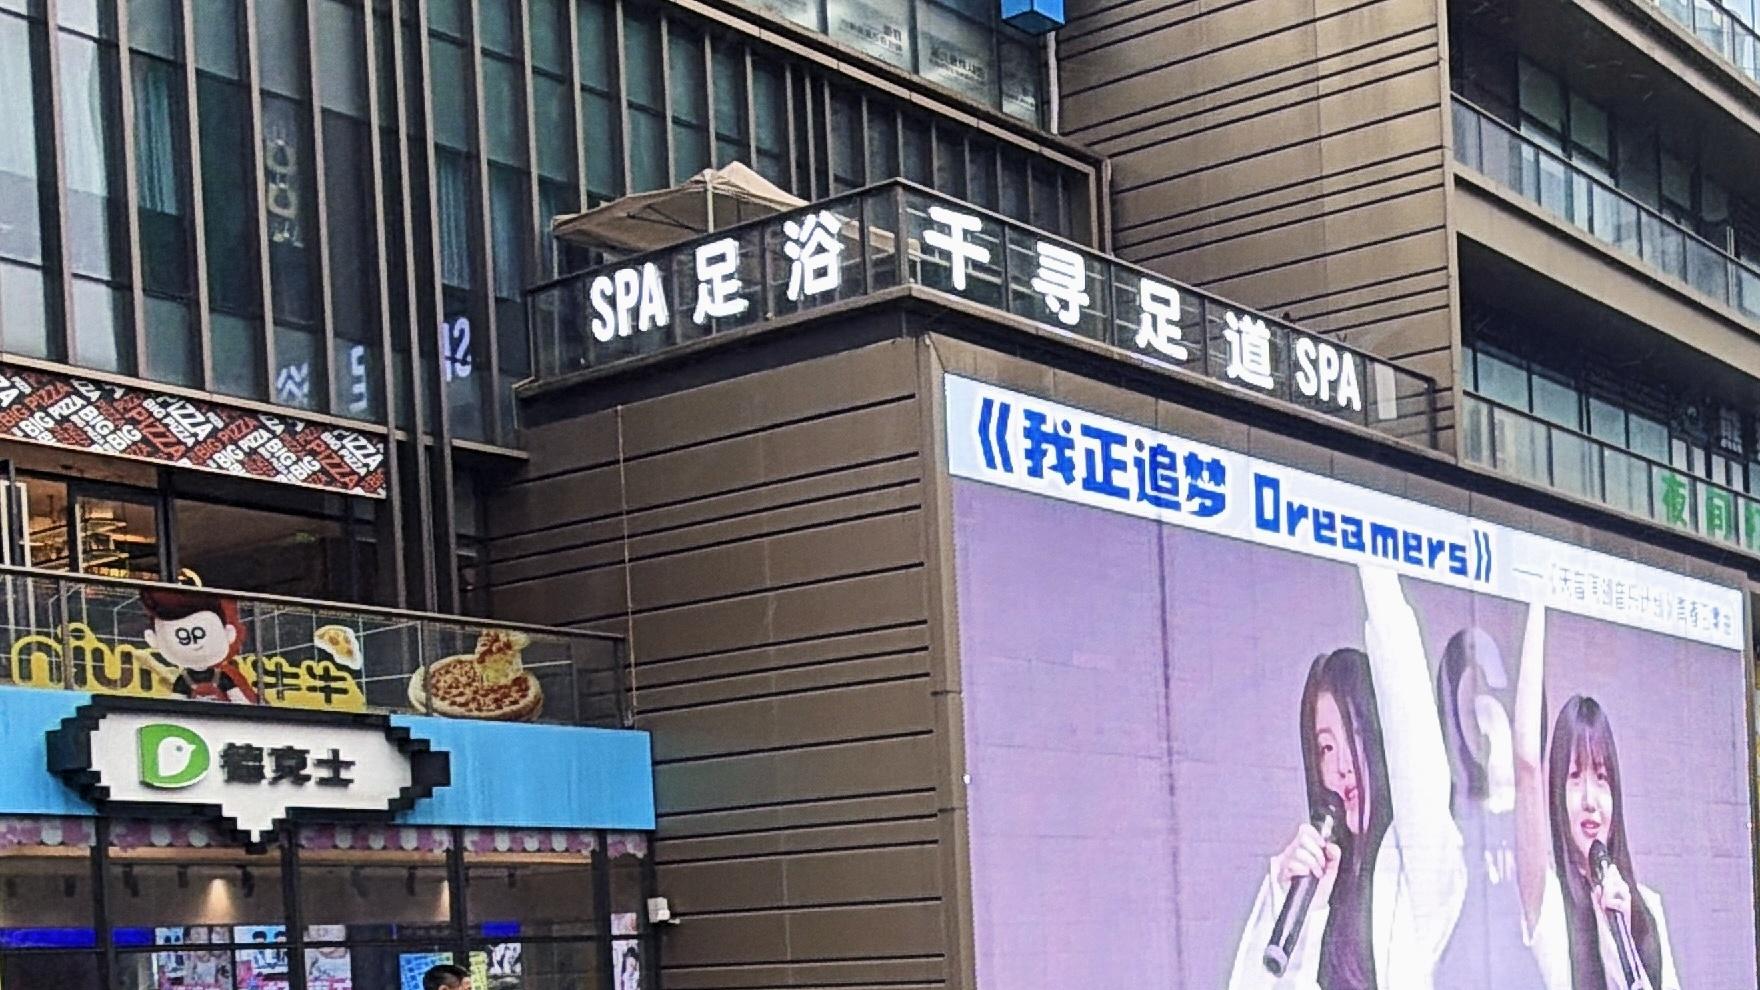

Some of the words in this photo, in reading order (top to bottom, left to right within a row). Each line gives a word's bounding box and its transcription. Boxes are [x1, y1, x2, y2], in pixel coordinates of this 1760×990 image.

[591, 262, 668, 342] SPA
[693, 211, 843, 325] 足浴
[925, 206, 1274, 391] 千寻足道
[1295, 337, 1362, 412] SPA
[19, 411, 55, 437] BIG
[47, 393, 88, 420] PIZZA
[978, 397, 1226, 518] 《我正追梦
